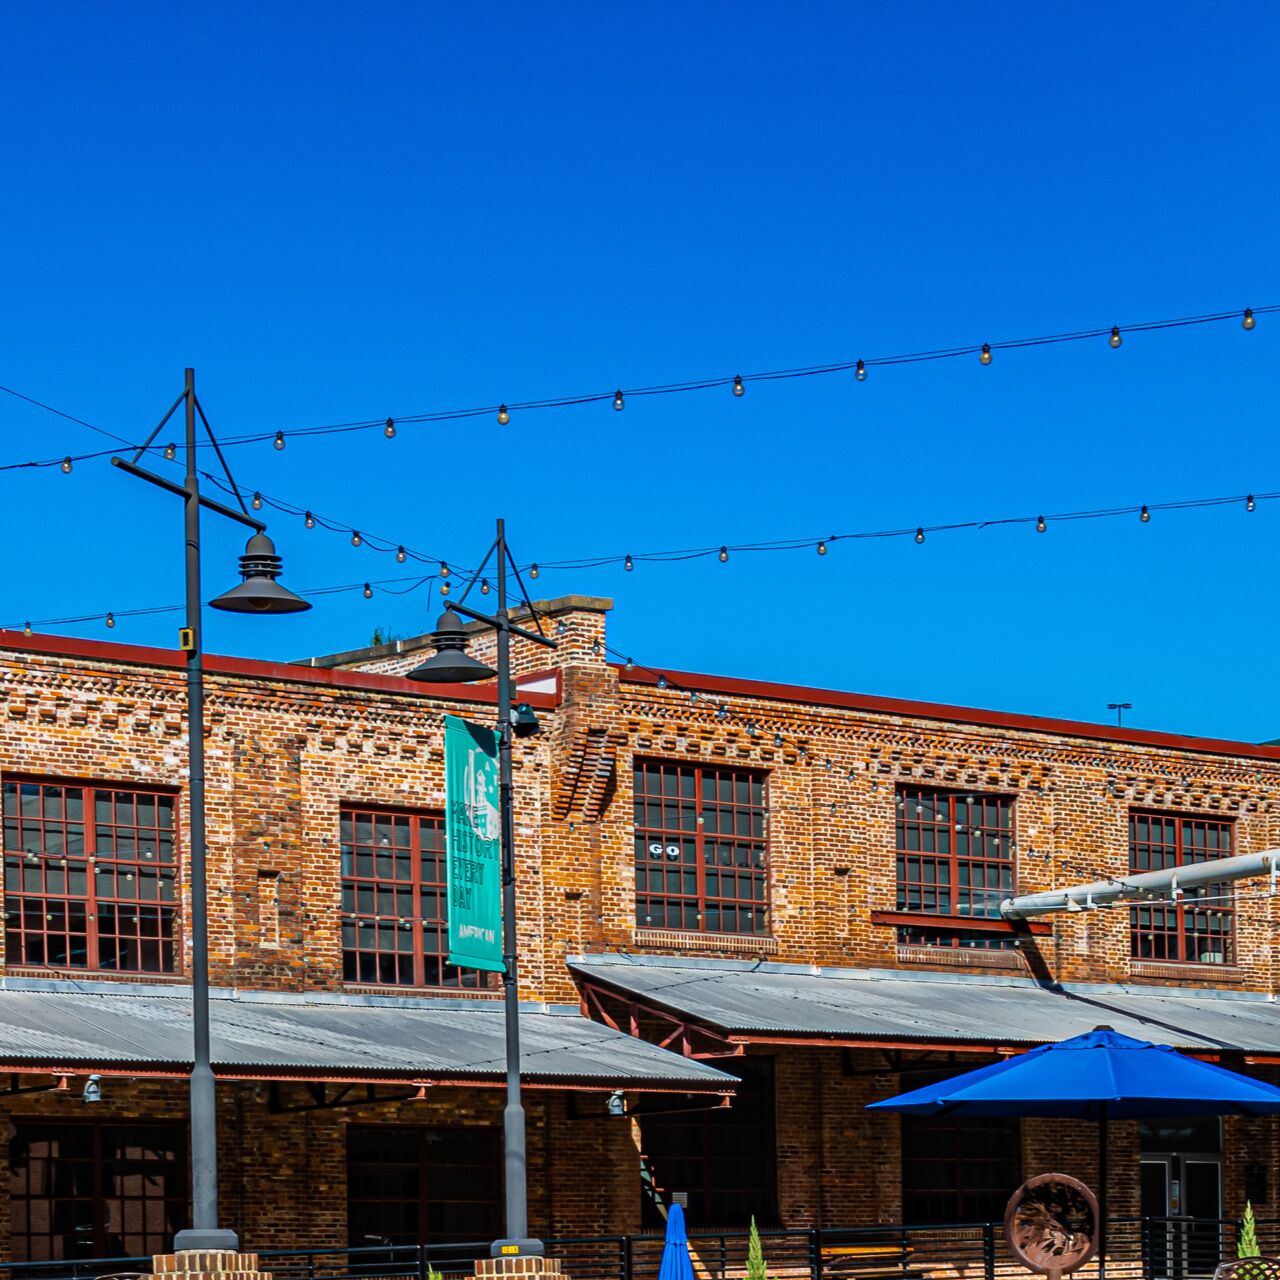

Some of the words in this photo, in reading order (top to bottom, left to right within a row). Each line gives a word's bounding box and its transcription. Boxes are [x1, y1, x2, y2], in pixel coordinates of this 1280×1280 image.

[451, 800, 478, 829] MAKE
[452, 828, 500, 861] HISTORY
[452, 856, 485, 885] EVERY
[453, 884, 472, 910] DAY
